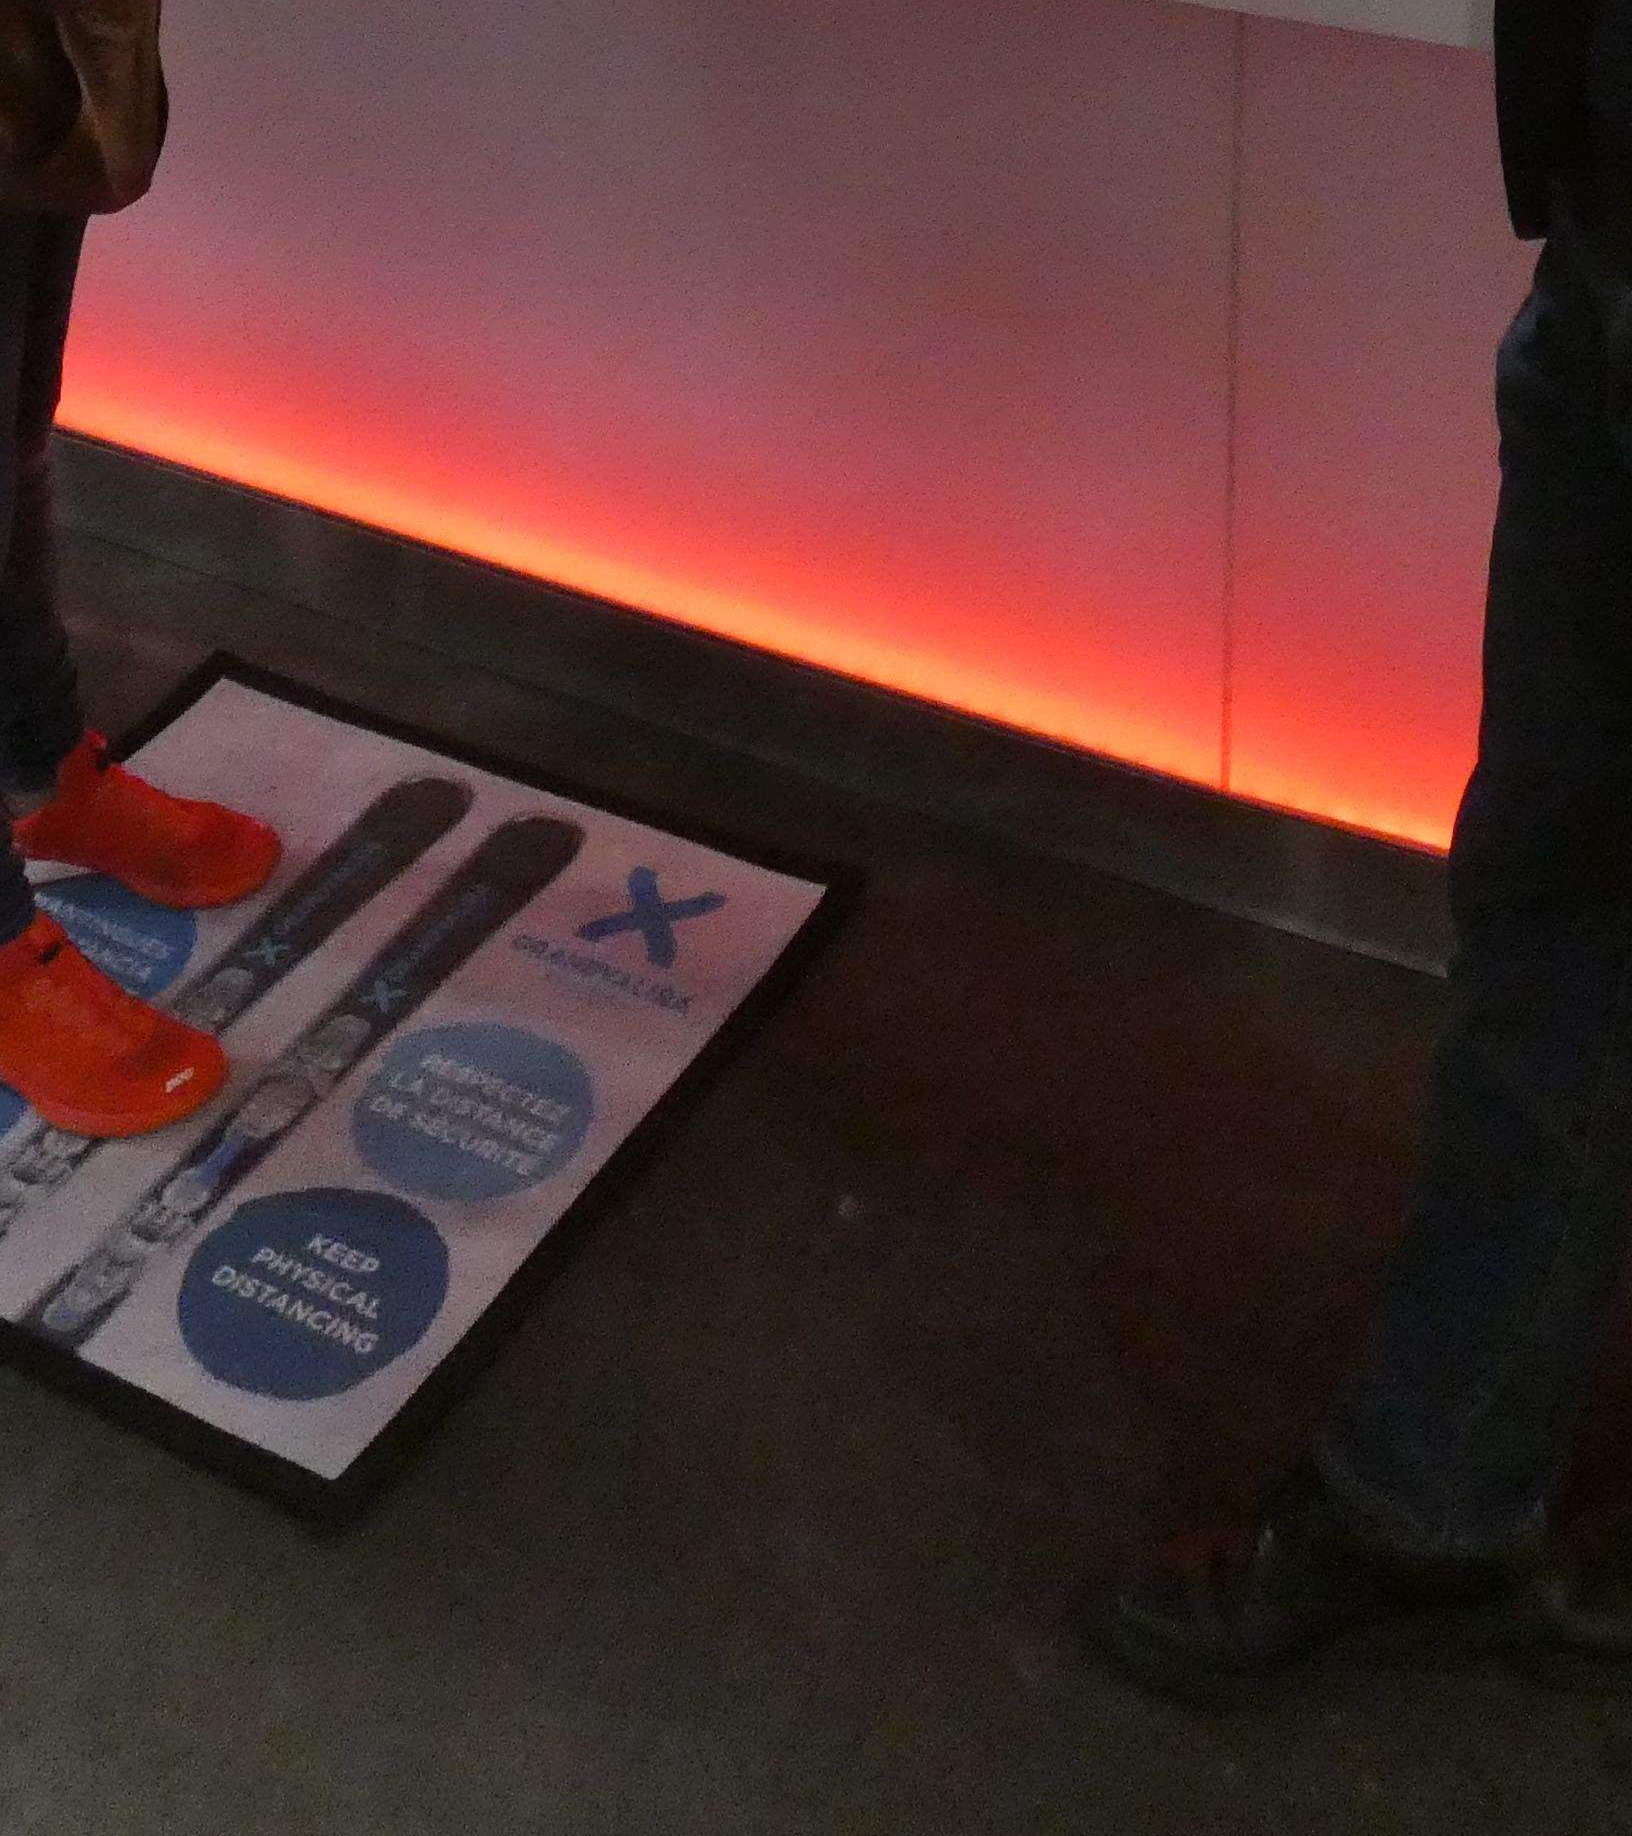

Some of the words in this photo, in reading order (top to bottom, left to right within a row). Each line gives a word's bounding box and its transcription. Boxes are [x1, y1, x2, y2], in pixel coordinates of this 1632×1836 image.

[250, 1246, 380, 1320] PHYSICAL
[305, 1233, 381, 1273] KEEP
[211, 1265, 379, 1354] DISTANCING
